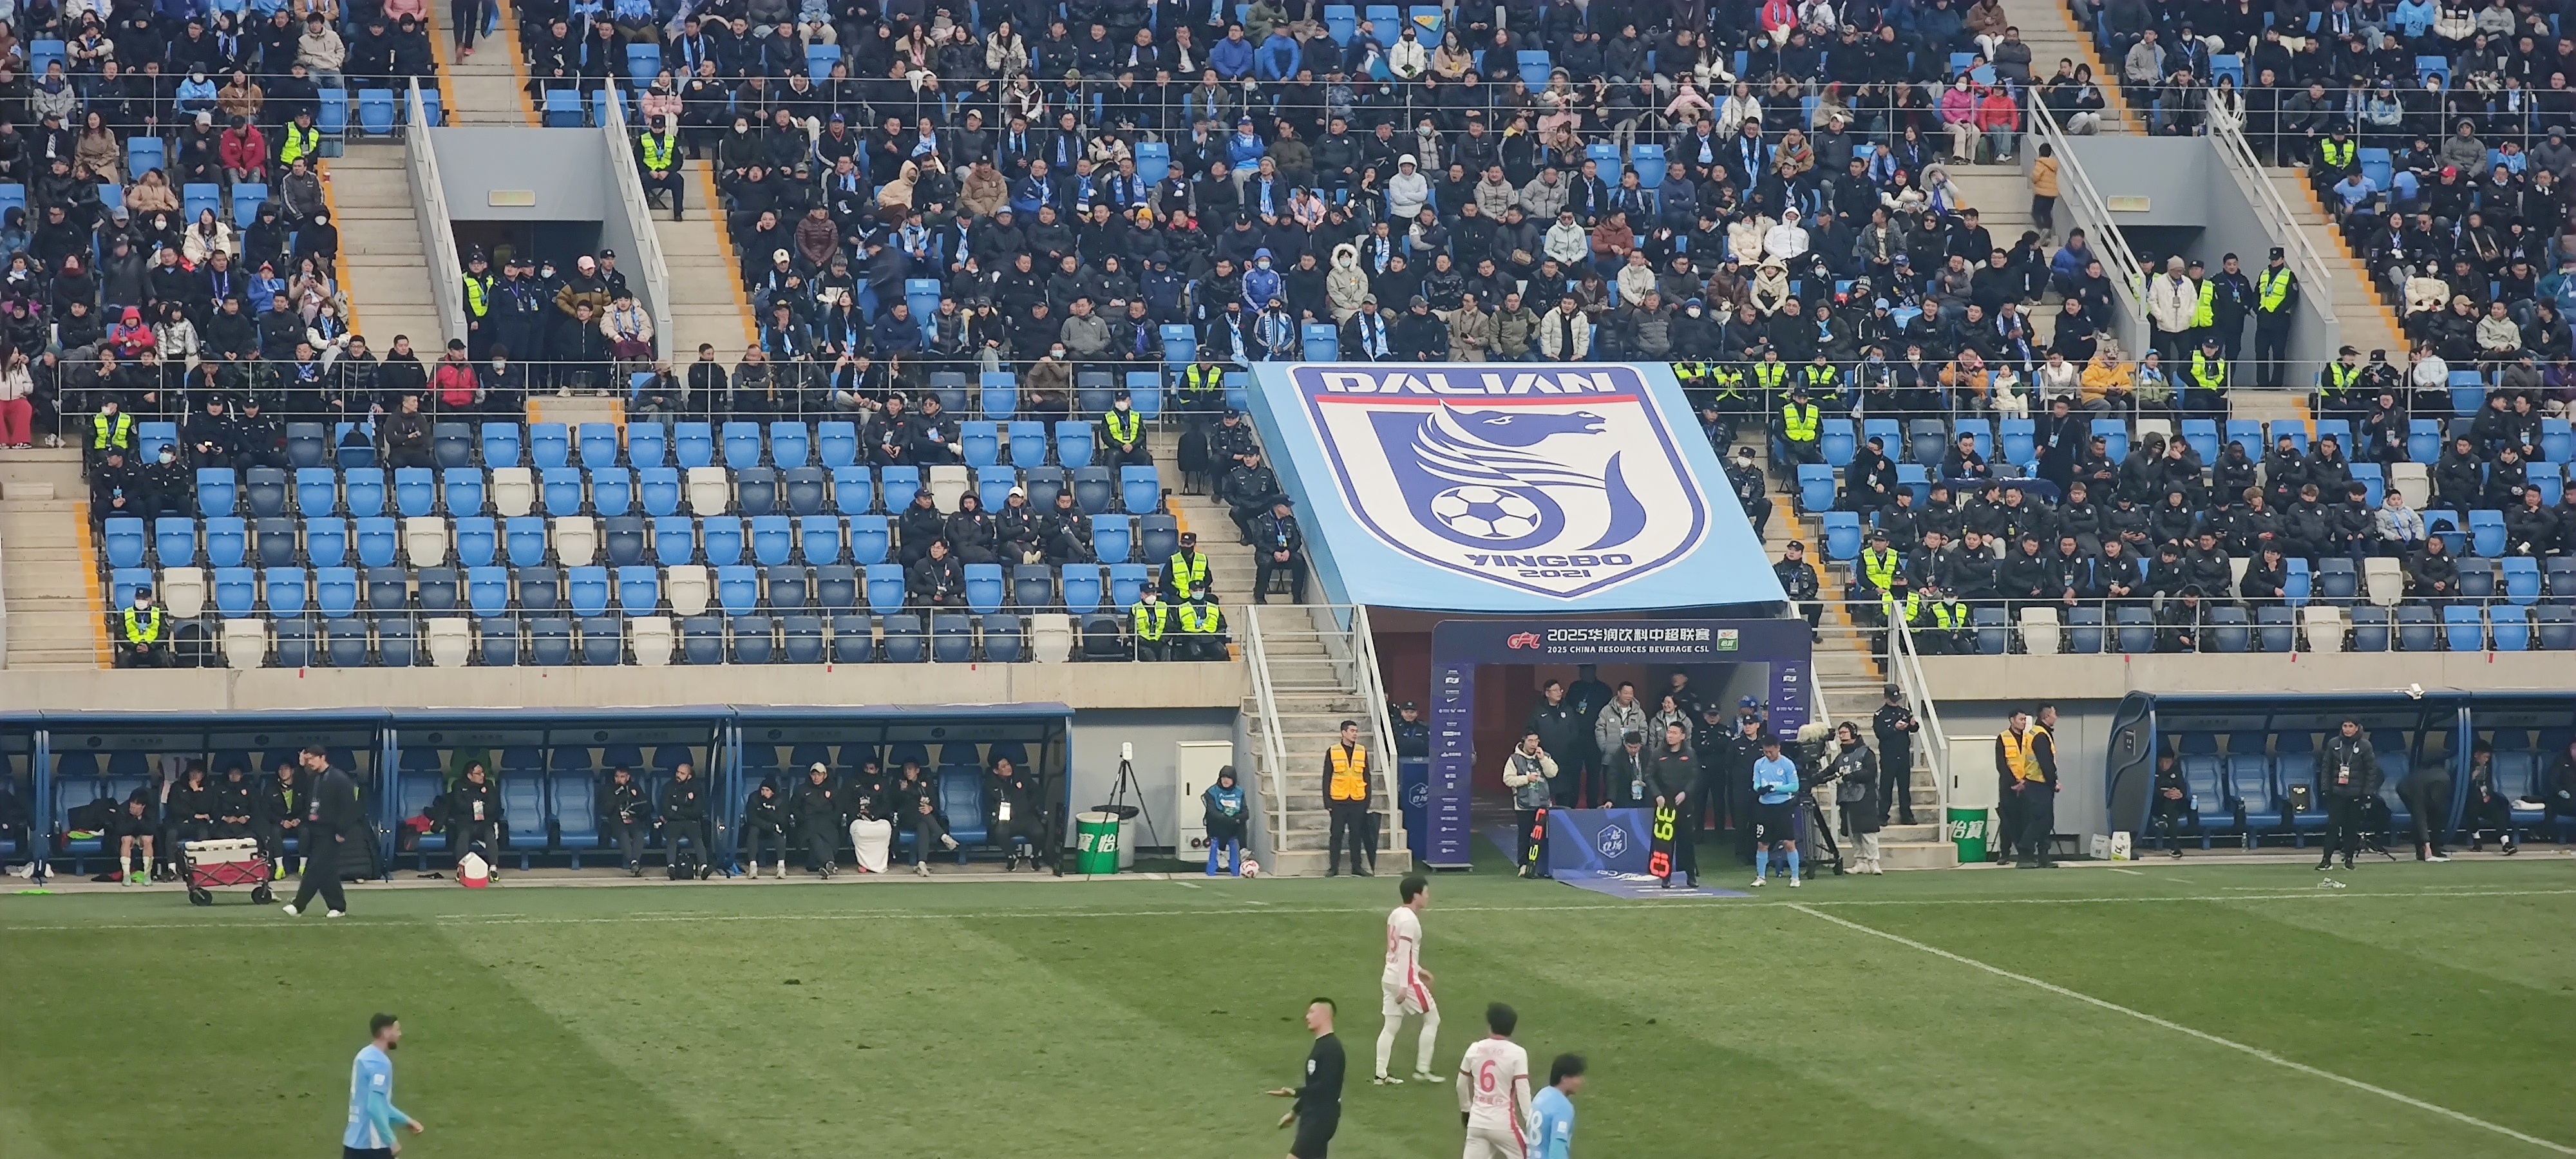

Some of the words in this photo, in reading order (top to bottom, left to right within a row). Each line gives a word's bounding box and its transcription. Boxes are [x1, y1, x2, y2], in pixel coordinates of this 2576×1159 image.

[1320, 372, 1616, 394] DALIAN
[1464, 554, 1633, 567] YINGBO
[1547, 628, 1710, 641] 2025华润饮料中超联赛
[1649, 851, 1671, 878] 10
[1480, 1059, 1496, 1093] 6
